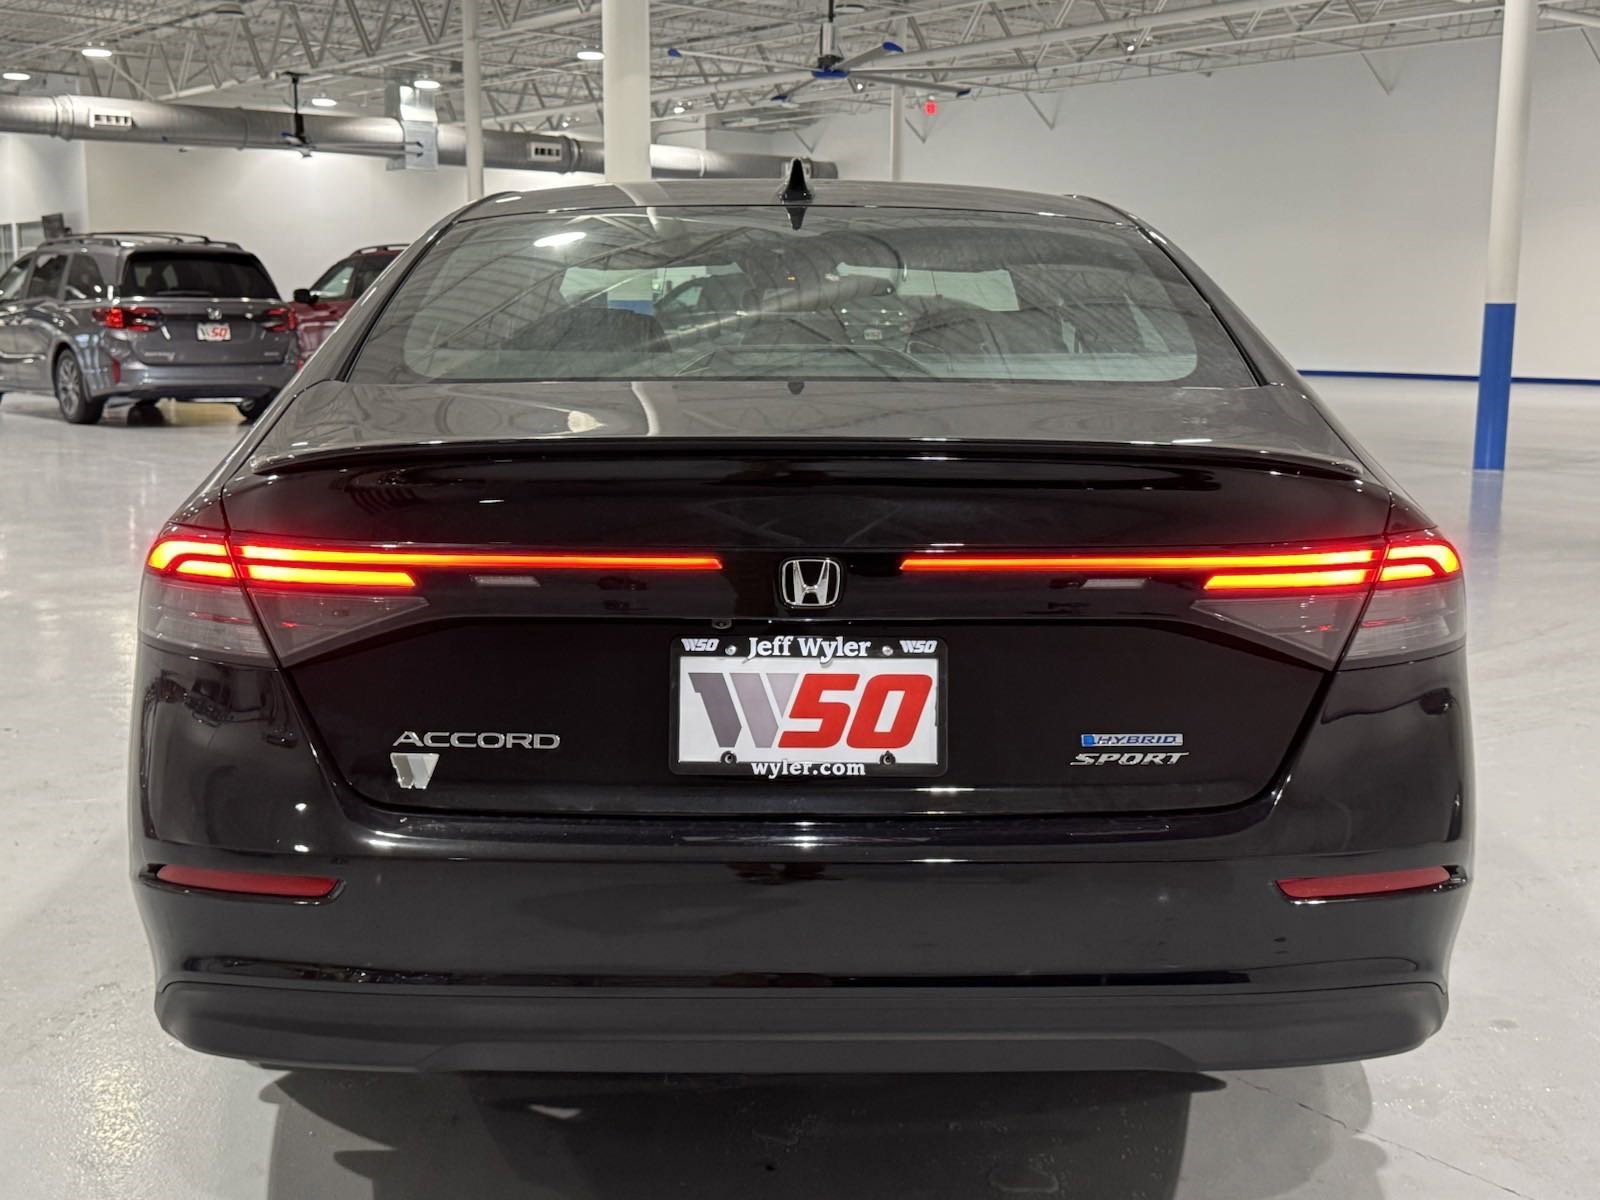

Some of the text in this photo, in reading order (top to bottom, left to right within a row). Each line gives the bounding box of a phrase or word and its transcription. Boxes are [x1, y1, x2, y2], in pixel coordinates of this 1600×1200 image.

[681, 638, 719, 651] W50
[747, 636, 871, 665] Jeff Wyler
[899, 640, 938, 653] W50
[687, 672, 933, 749] W50
[392, 731, 561, 749] ACCORD
[1096, 735, 1177, 745] HYBRID
[1069, 751, 1190, 766] SPORT
[750, 759, 866, 779] wyler.com
